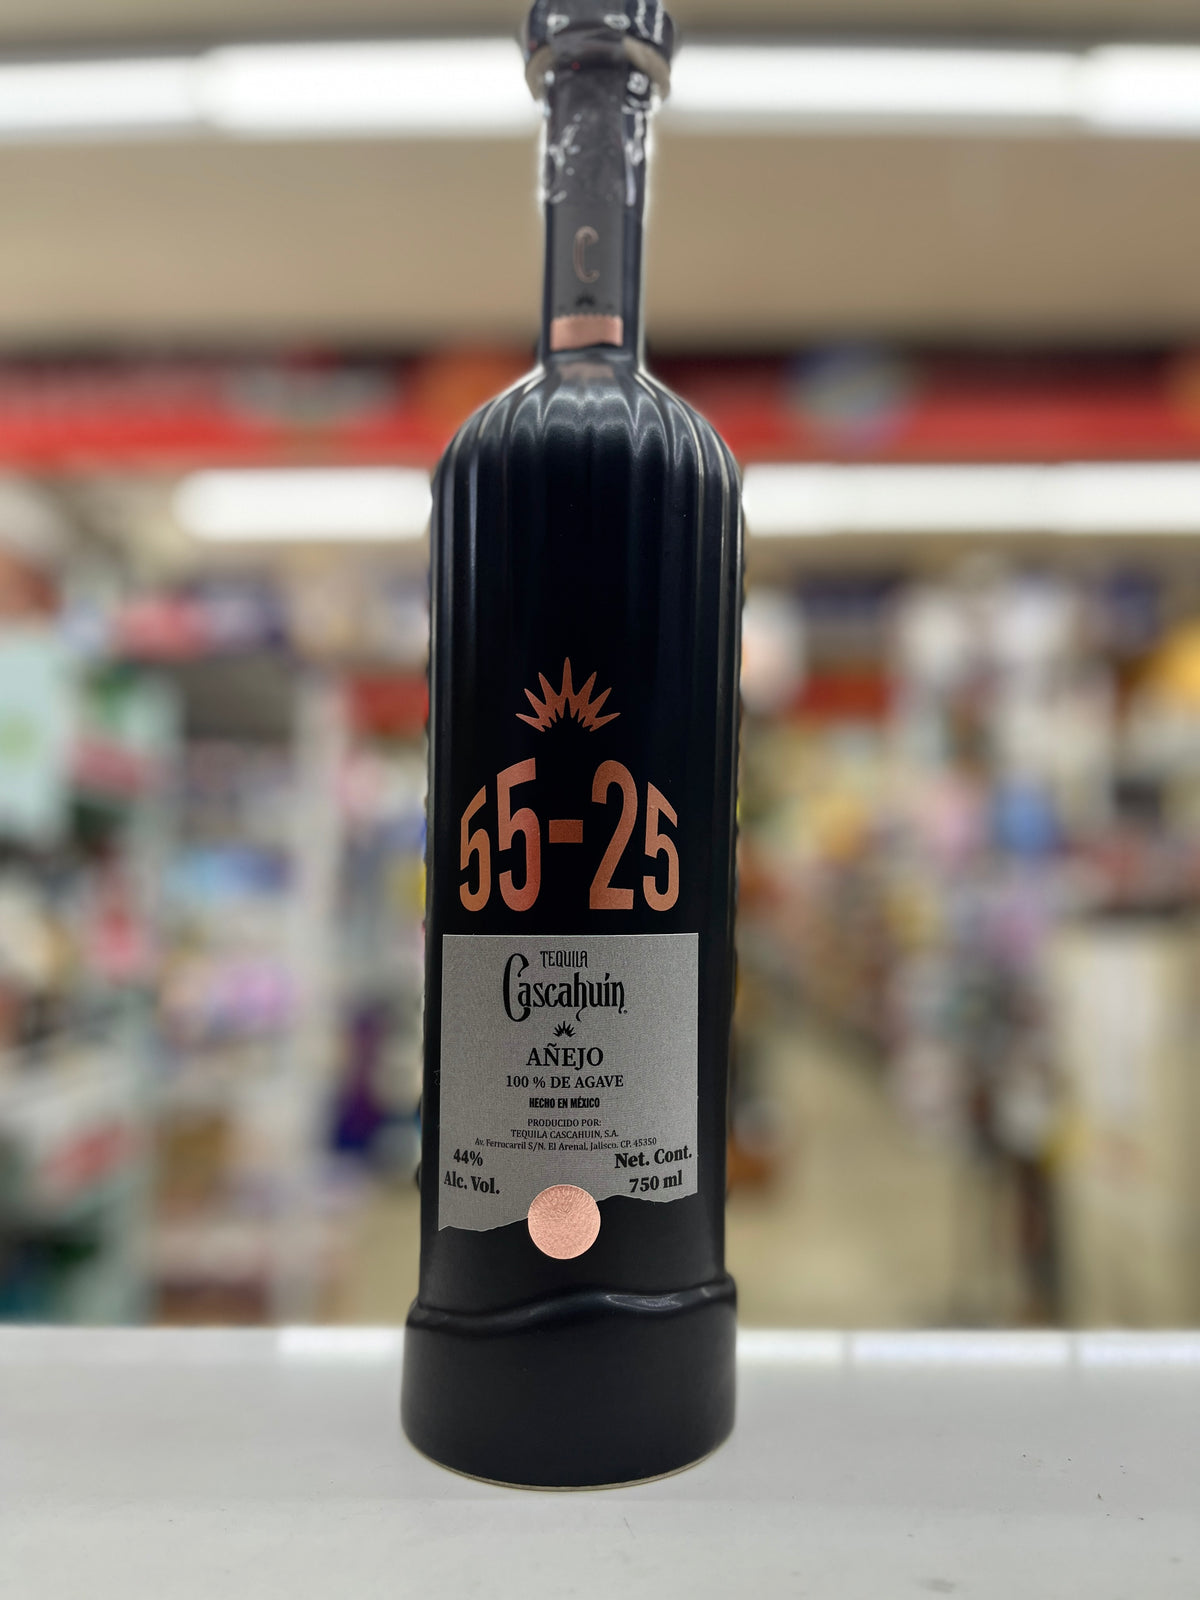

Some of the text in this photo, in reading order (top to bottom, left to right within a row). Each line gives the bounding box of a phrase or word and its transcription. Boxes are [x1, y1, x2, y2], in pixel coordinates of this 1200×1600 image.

[459, 757, 680, 912] 55-25
[540, 950, 589, 969] TEQUILA
[526, 1042, 604, 1071] AÑEJO
[506, 1075, 624, 1088] 100 % DE AGAVE
[529, 1095, 600, 1108] HECHO EN MÉXICO
[527, 1118, 602, 1127] PRODUCIDO POR:
[486, 1138, 526, 1150] Ferrocarril
[548, 1142, 557, 1150] El
[633, 1136, 657, 1147] 45350
[510, 1129, 548, 1139] TEQUILA
[604, 1129, 619, 1138] S.A.
[453, 1149, 483, 1167] 44%
[614, 1145, 693, 1169] Net. Cont.
[444, 1171, 500, 1194] Alc. Vol.
[629, 1170, 683, 1193] 750 ml
